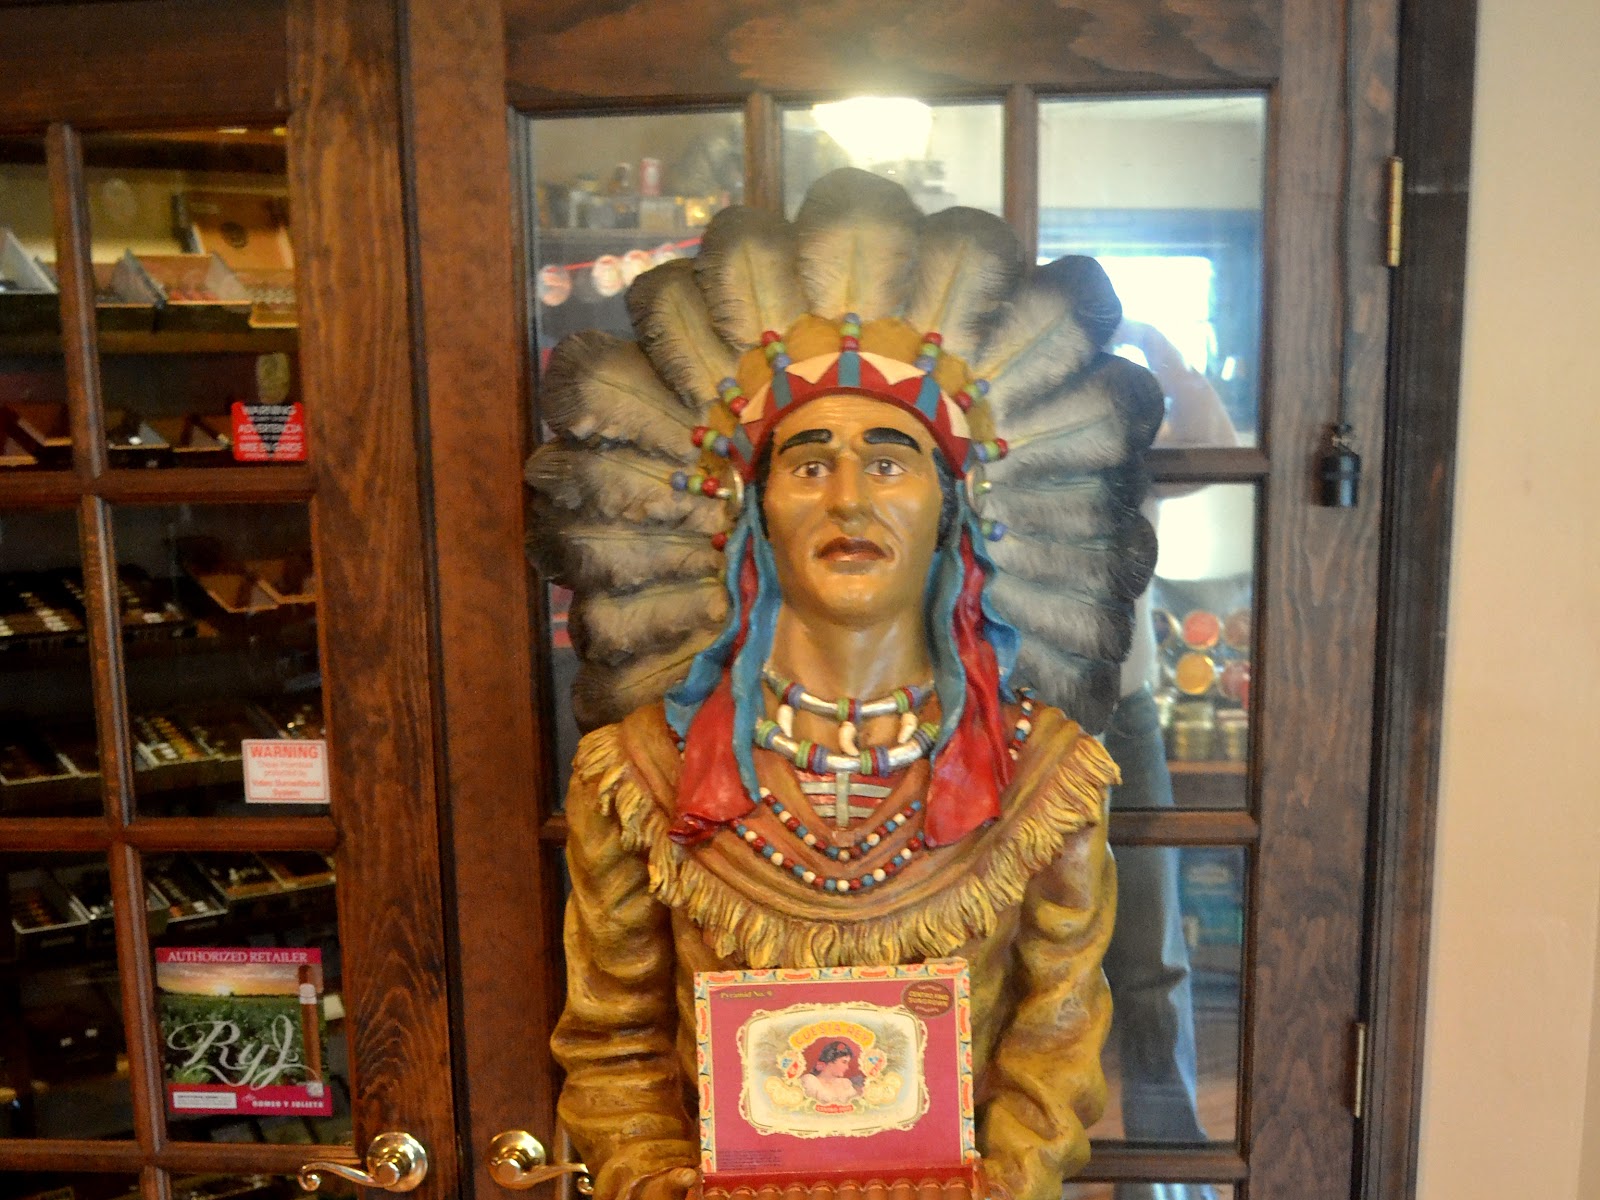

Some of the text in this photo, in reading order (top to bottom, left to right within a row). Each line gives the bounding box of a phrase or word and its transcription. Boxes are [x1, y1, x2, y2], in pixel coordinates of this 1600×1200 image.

[250, 745, 319, 759] WARNING
[168, 951, 308, 963] AUTHORIZED RETAILER
[794, 1023, 871, 1045] CUESTA REY
